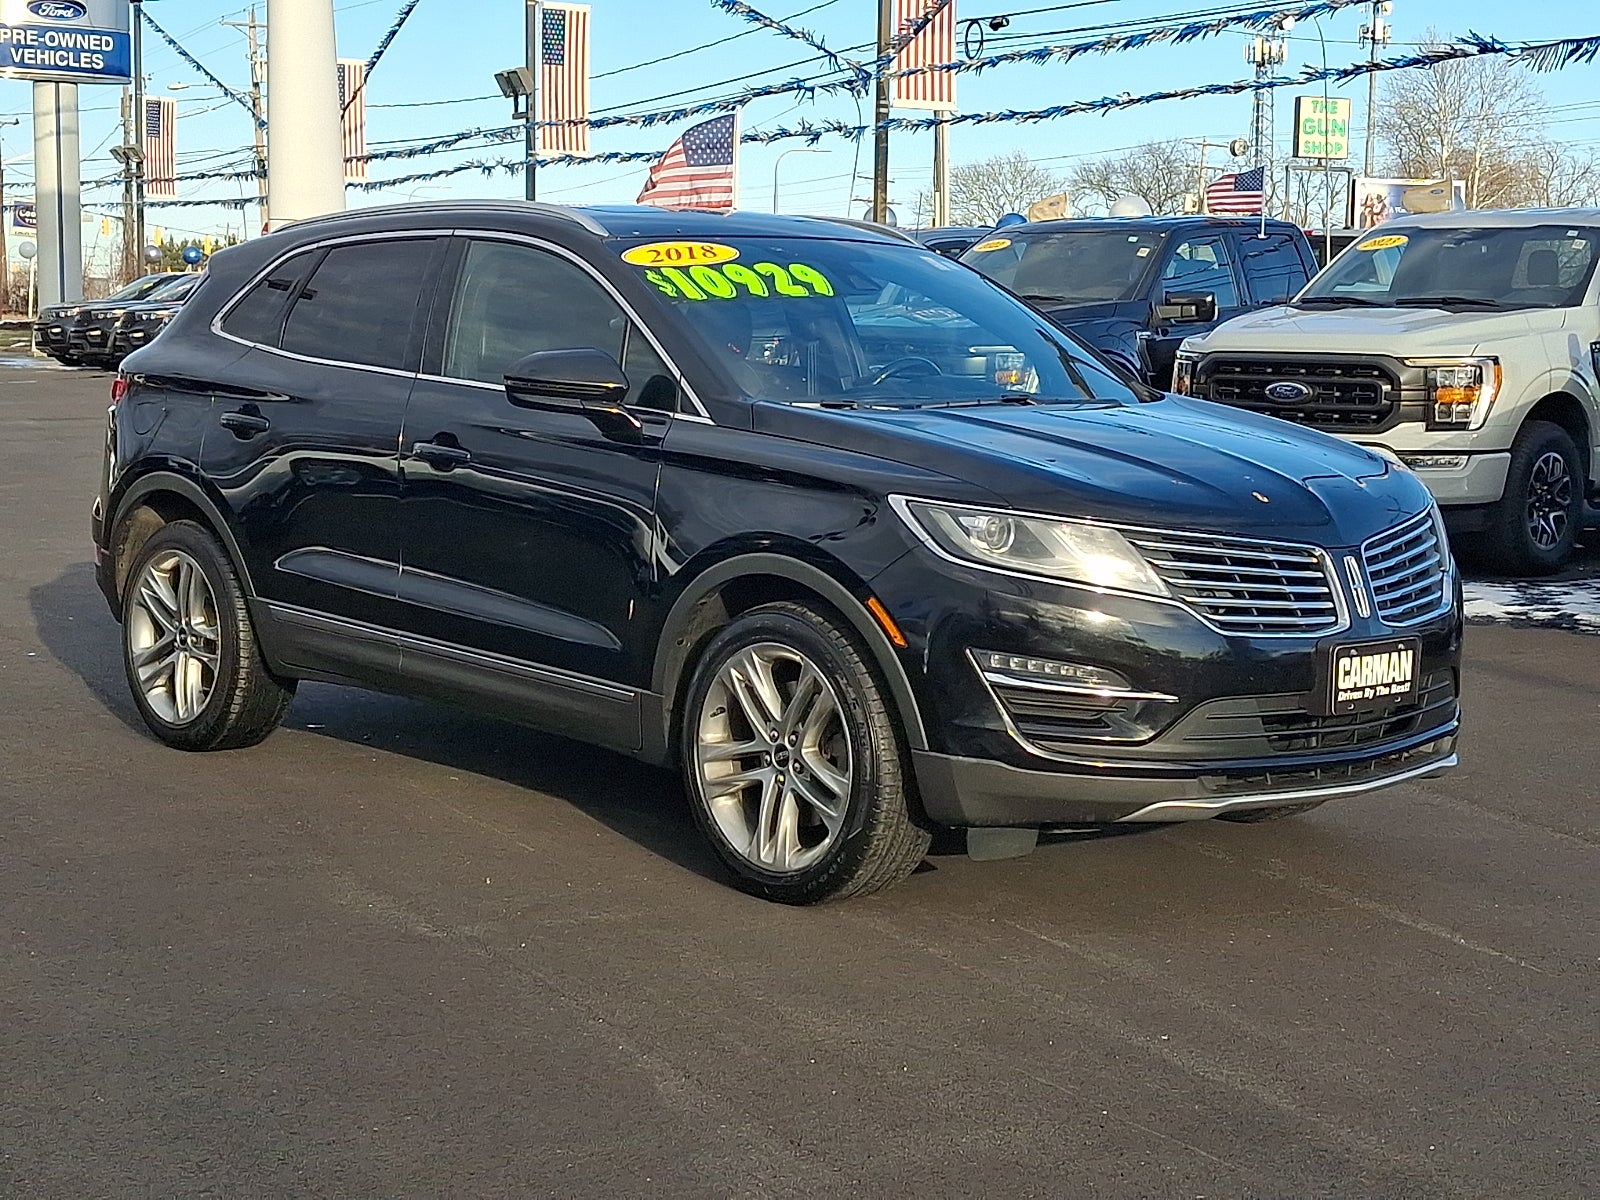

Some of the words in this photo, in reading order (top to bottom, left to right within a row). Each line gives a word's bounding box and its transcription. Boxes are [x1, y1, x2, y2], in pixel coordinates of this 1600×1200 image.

[39, 2, 74, 17] Ford
[0, 28, 113, 51] PRE-OWNED
[10, 47, 104, 69] VEHICLES
[1312, 100, 1338, 114] THE
[1303, 117, 1345, 137] GUN
[1304, 140, 1343, 155] SHOP
[646, 245, 717, 263] 2018
[644, 262, 835, 300] $10929
[1338, 650, 1413, 690] CARMAN
[1337, 690, 1363, 701] Driven
[1364, 687, 1375, 699] By
[1376, 685, 1390, 696] The
